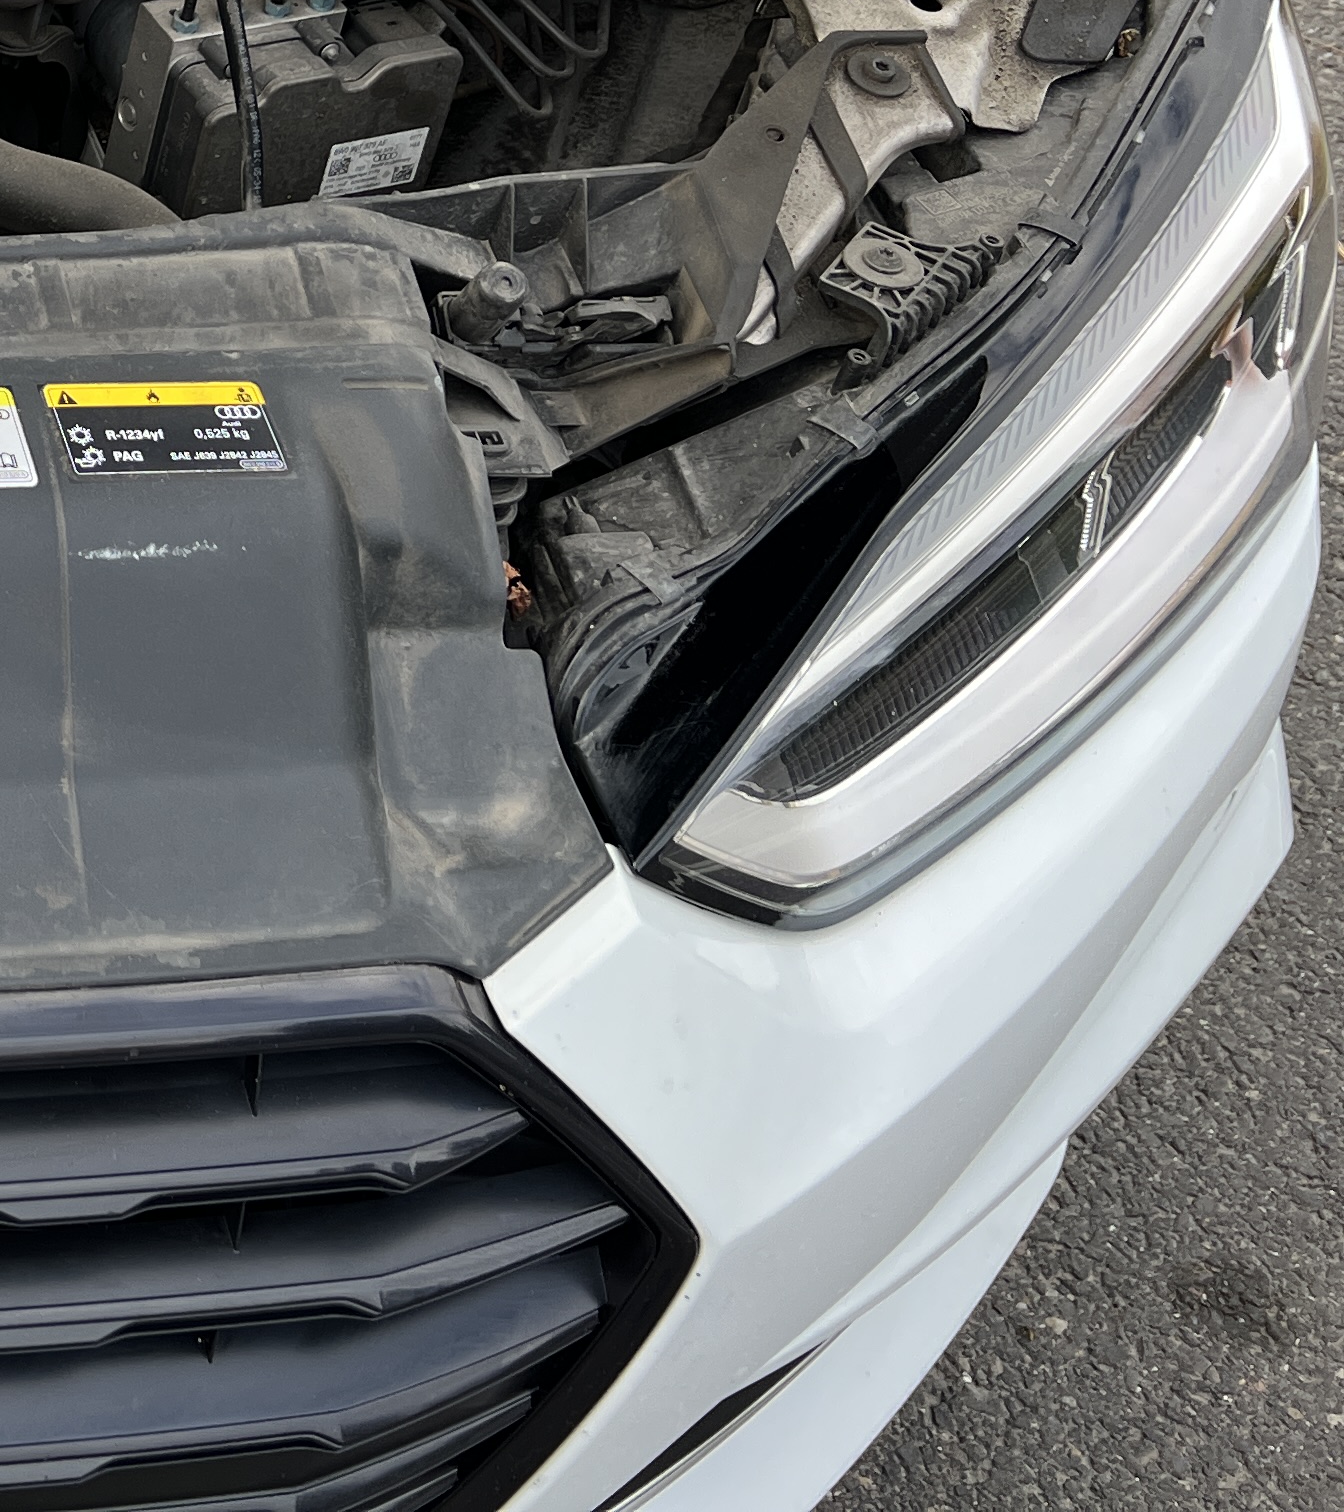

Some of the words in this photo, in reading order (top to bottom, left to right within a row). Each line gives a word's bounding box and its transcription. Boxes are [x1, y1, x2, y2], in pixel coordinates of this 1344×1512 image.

[105, 428, 165, 442] R-1234yf
[193, 427, 230, 440] 0,525
[231, 427, 251, 441] kg
[112, 450, 145, 462] PAG
[170, 451, 191, 461] SAE
